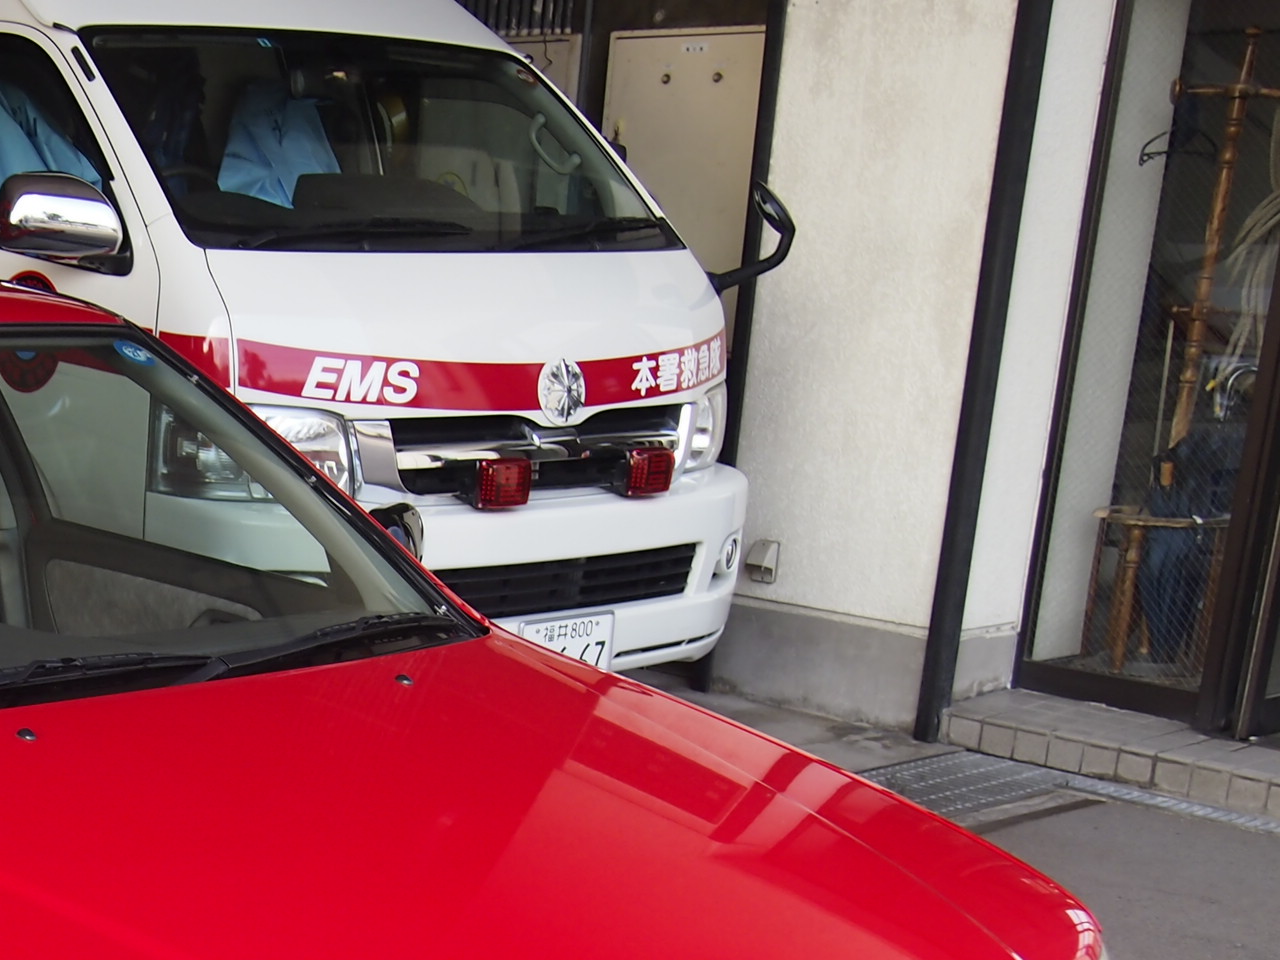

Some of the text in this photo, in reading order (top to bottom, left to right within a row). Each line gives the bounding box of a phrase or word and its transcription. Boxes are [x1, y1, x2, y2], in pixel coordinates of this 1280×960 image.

[301, 355, 420, 404] EMS
[631, 335, 721, 398] 本署救急隊
